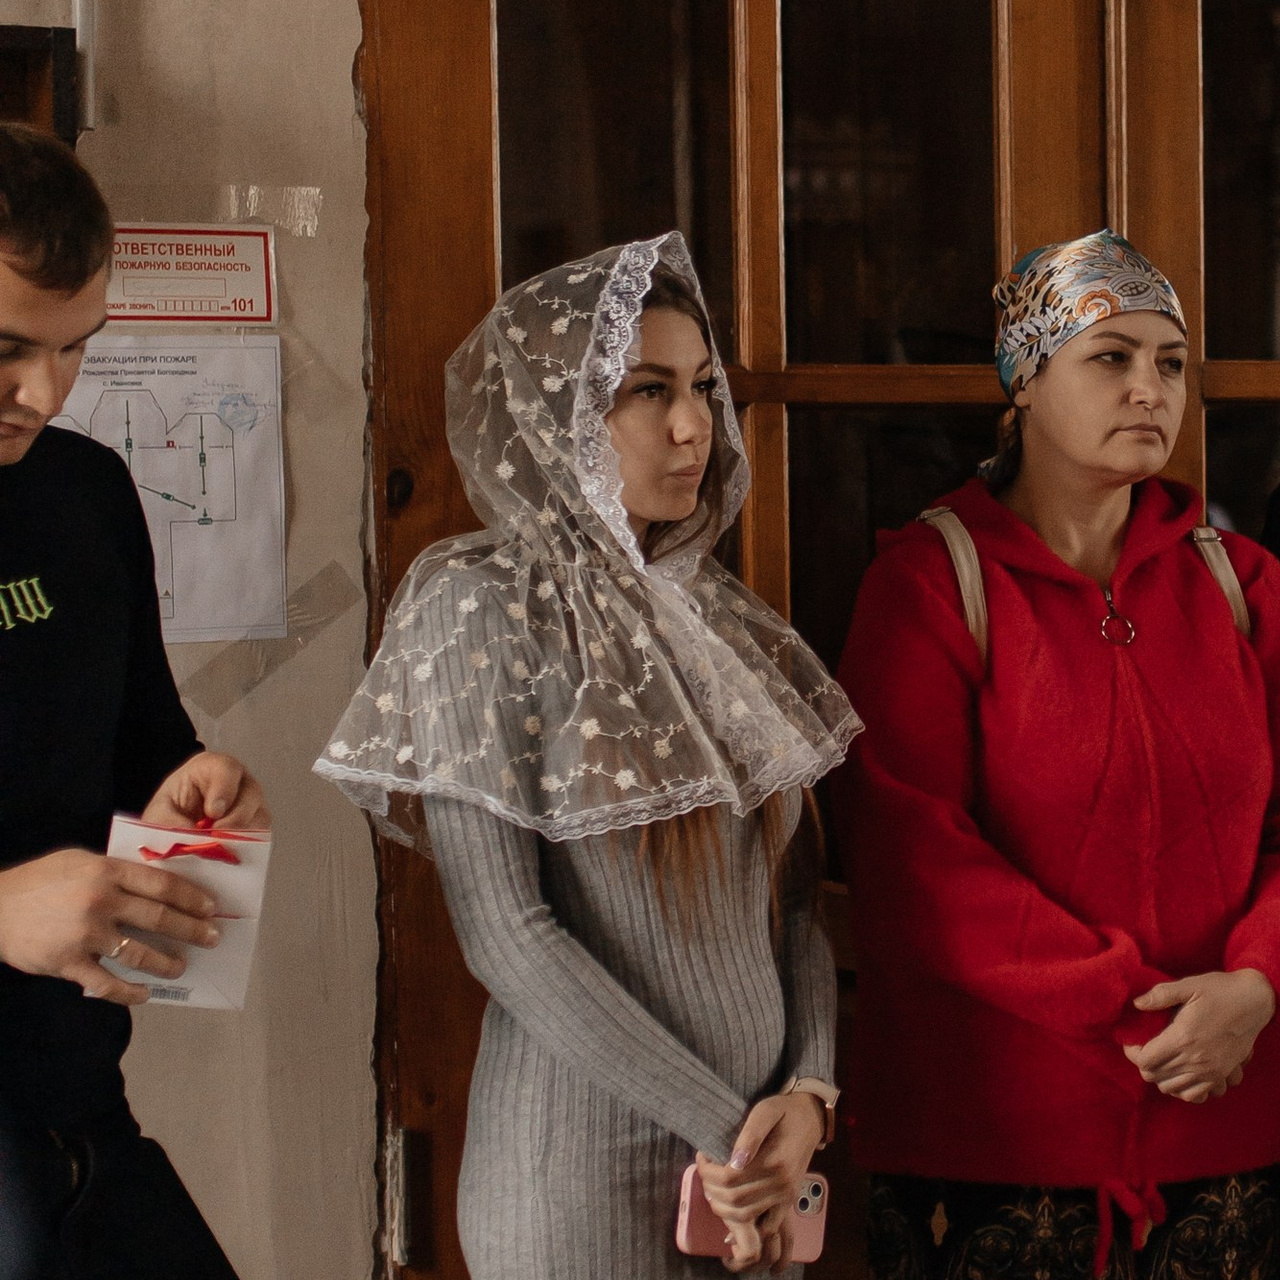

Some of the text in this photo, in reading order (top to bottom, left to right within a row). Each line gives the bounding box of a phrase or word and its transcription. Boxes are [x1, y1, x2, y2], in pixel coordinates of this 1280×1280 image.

[112, 241, 235, 257] ОТВЕТСТВЕННЫЙ
[115, 260, 252, 273] ПОЖАРНУЮ БЕЗОПАСНОСТЬ
[106, 302, 127, 310] ОЖАРЕ
[231, 298, 254, 312] 101
[83, 355, 197, 365] ЭВАКУАЦИИ ПРИ ПОЖАРЕ
